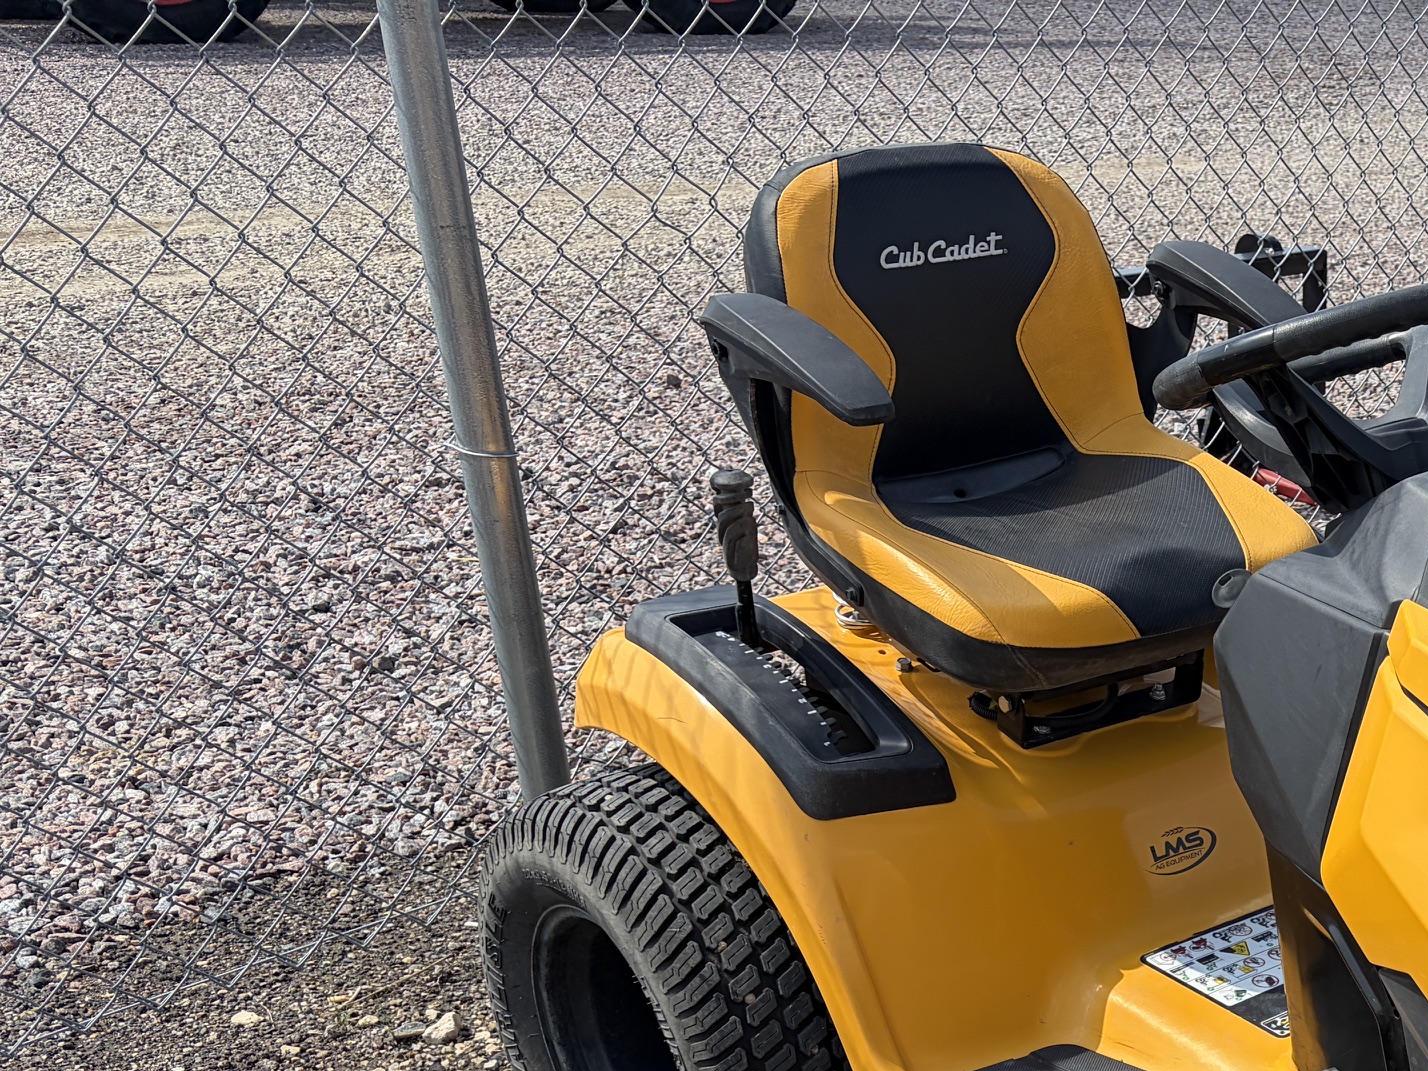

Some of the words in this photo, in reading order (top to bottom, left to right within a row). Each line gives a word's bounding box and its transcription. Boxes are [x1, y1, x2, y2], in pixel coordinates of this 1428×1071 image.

[880, 241, 926, 269] Cub
[927, 231, 1003, 263] Cadet
[1150, 830, 1204, 862] LMS
[1155, 862, 1165, 871] AG
[1166, 850, 1204, 867] EQUIPMENT
